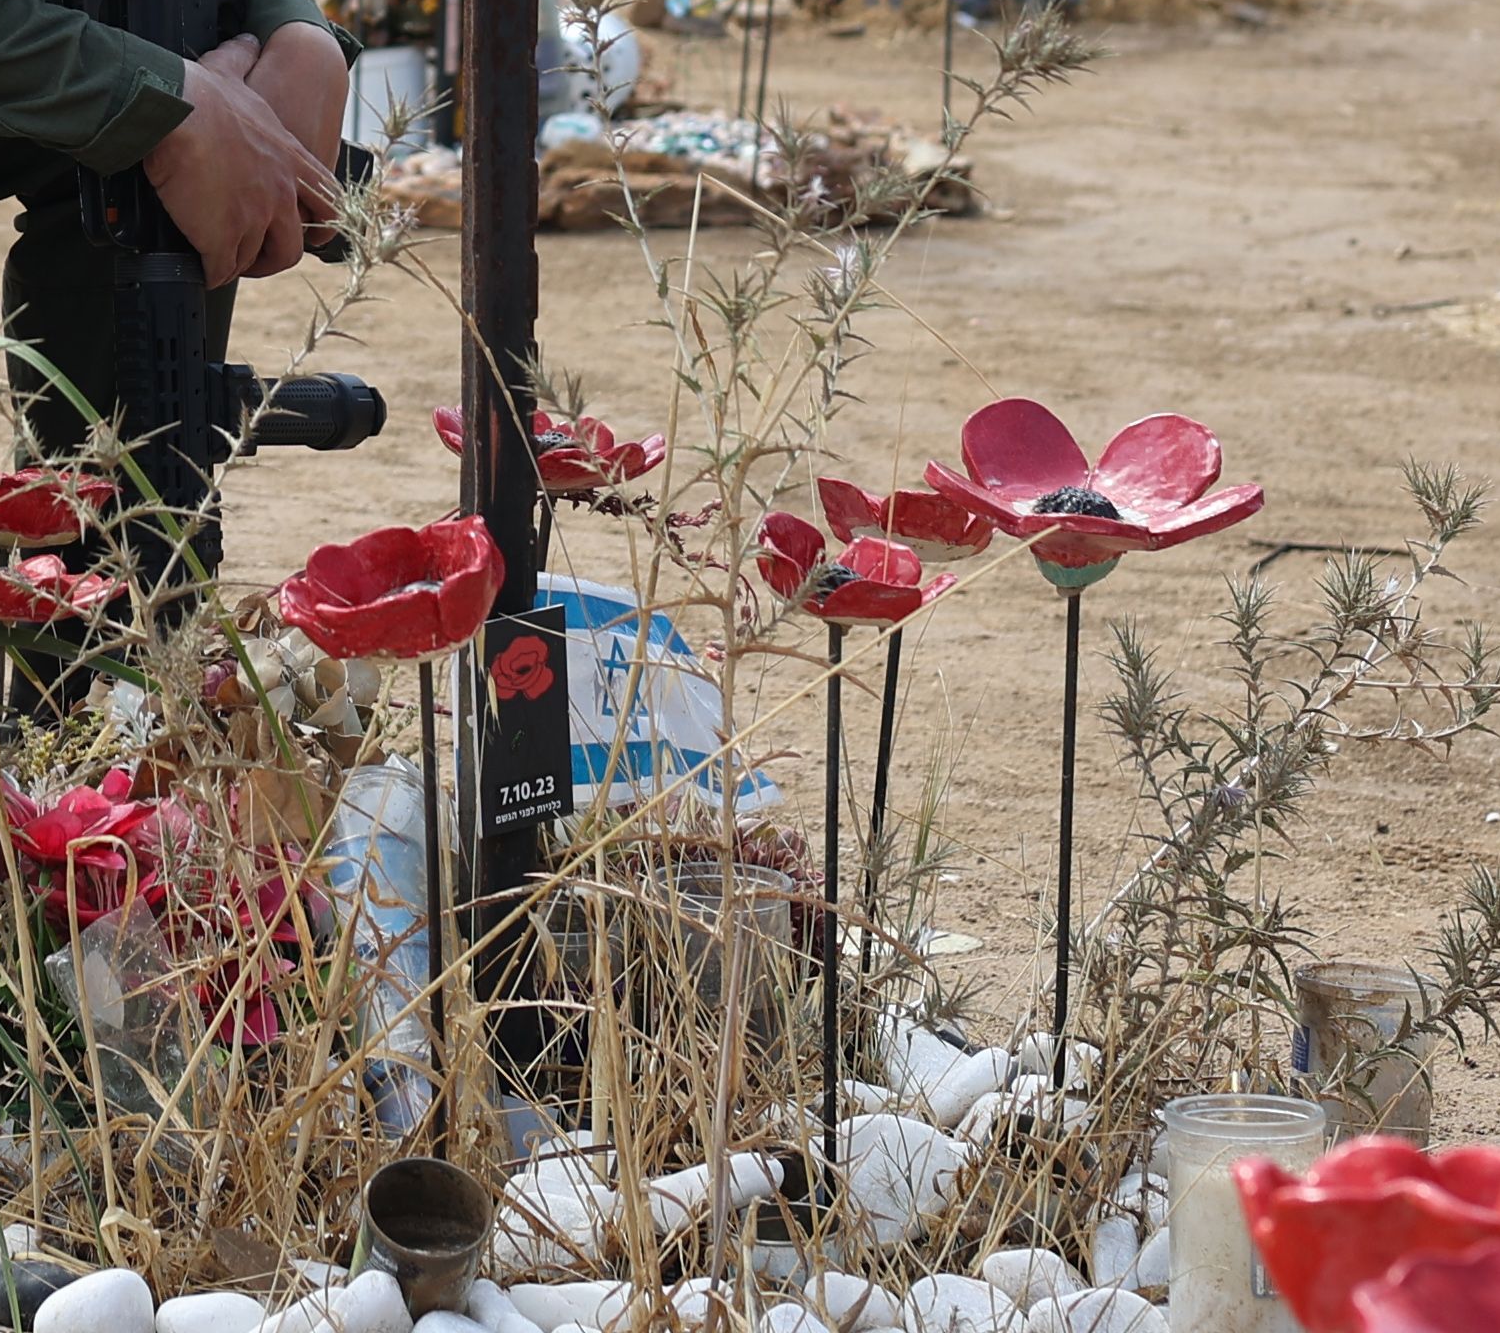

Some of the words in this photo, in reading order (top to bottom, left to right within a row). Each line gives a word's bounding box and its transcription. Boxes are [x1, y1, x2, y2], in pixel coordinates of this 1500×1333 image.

[500, 775, 555, 806] 7.10.23
[519, 804, 536, 818] לפני
[536, 799, 562, 814] כלניות
[495, 812, 518, 825] הגשם
